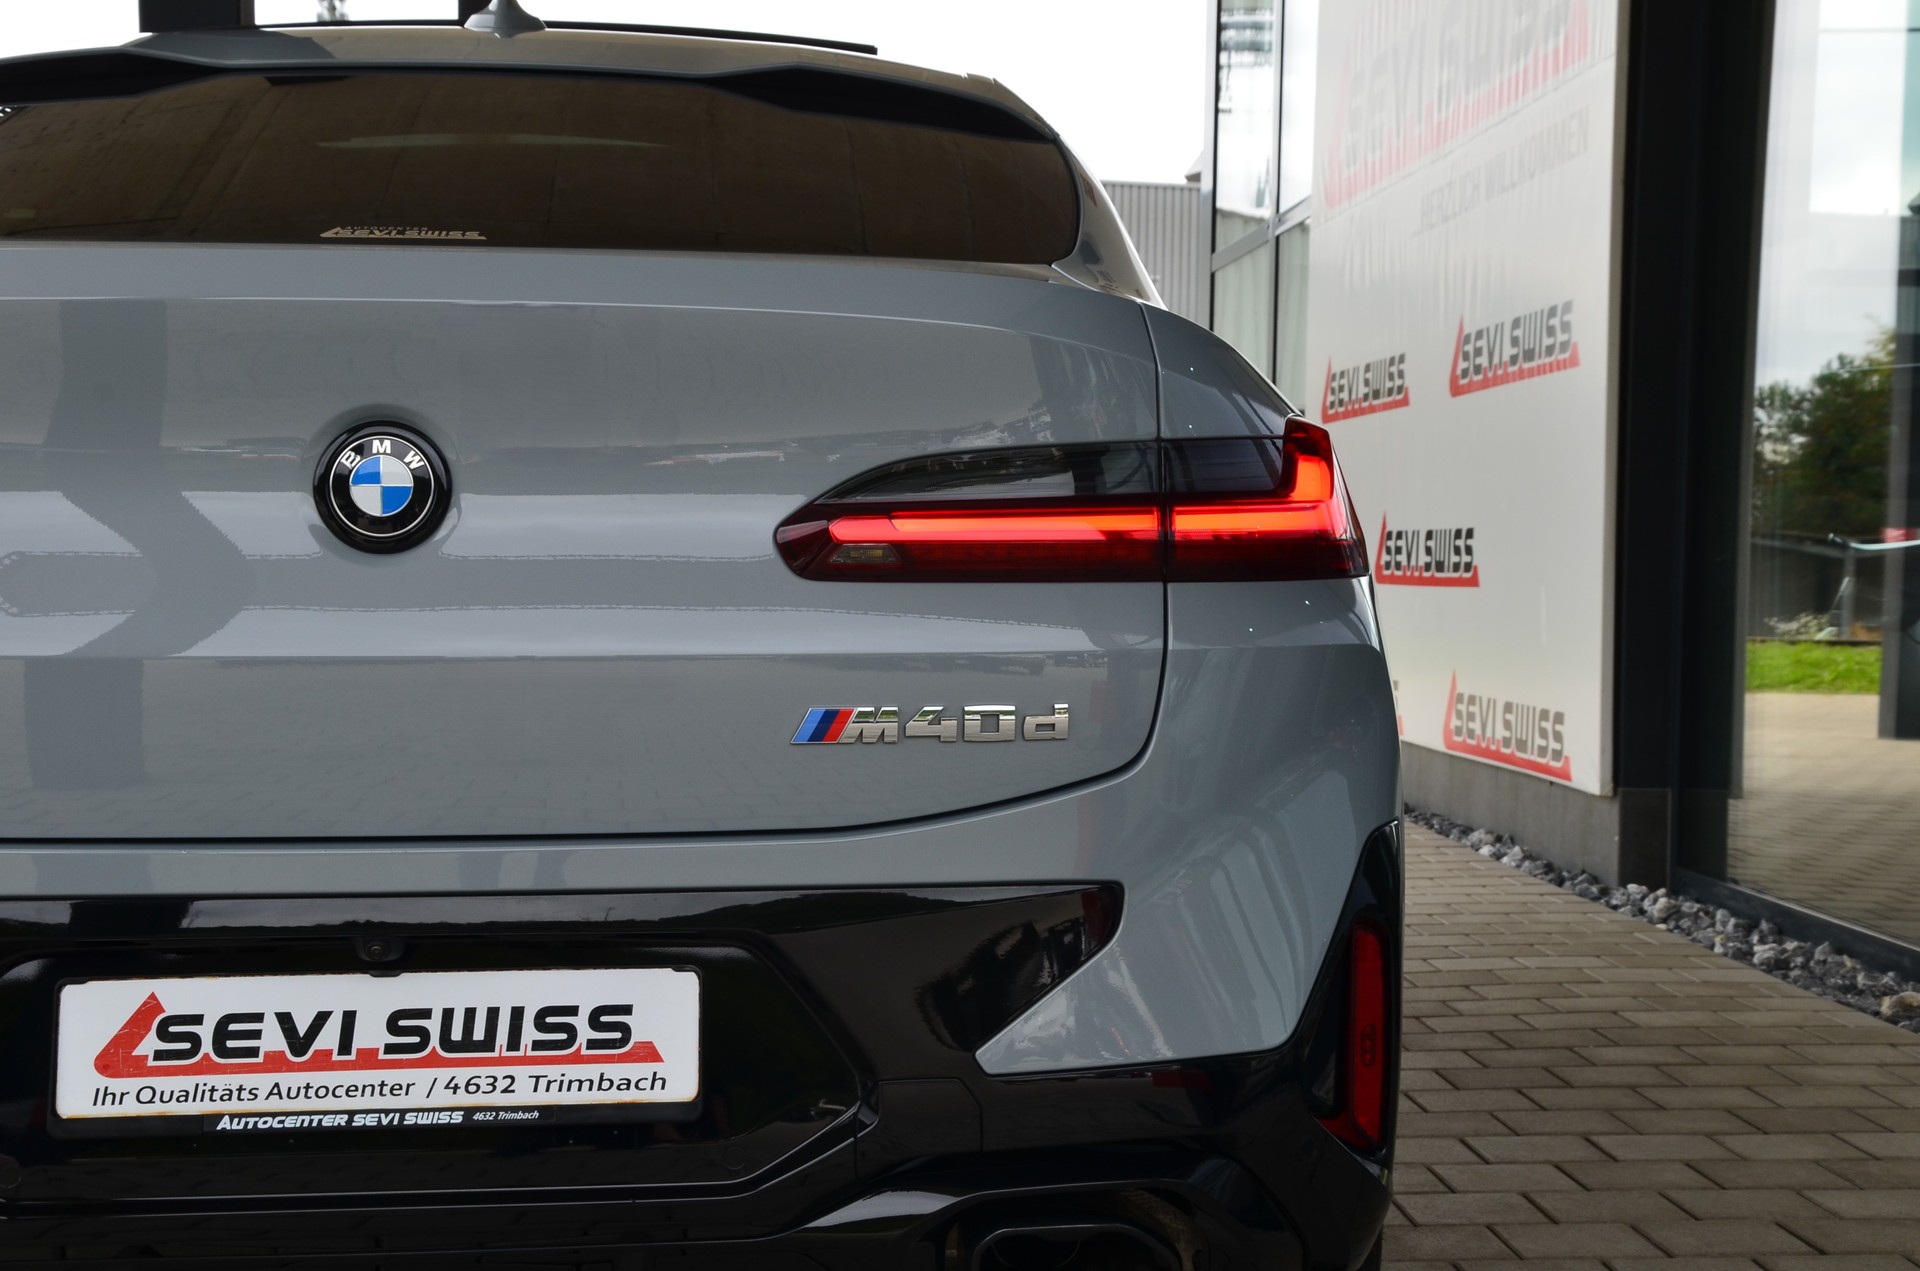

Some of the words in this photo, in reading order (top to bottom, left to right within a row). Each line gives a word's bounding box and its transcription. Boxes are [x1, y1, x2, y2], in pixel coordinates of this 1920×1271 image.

[336, 229, 397, 238] SEVI
[404, 230, 480, 239] SWISS
[1460, 322, 1505, 381] SEVI
[1510, 299, 1573, 368] SWISS
[1328, 365, 1359, 412] SEVI
[1363, 352, 1406, 404] SWISS
[339, 438, 425, 470] BMW
[1383, 529, 1420, 573] SEVI
[1424, 527, 1475, 574] SWISS
[838, 703, 1069, 744] M40d
[1454, 692, 1497, 747] SEVI
[1502, 701, 1564, 764] SWISS
[152, 1010, 358, 1062] SEVI
[383, 1004, 634, 1056] SWISS
[92, 1085, 129, 1107] Ihr
[135, 1082, 259, 1105] Qualitäts
[265, 1078, 416, 1101] Autocenter
[444, 1074, 517, 1096] 4632
[528, 1071, 667, 1093] Trimbach
[351, 1112, 400, 1127] SEVI
[403, 1110, 464, 1125] SWISS
[472, 1111, 495, 1121] 4632
[497, 1109, 540, 1120] Trimbach
